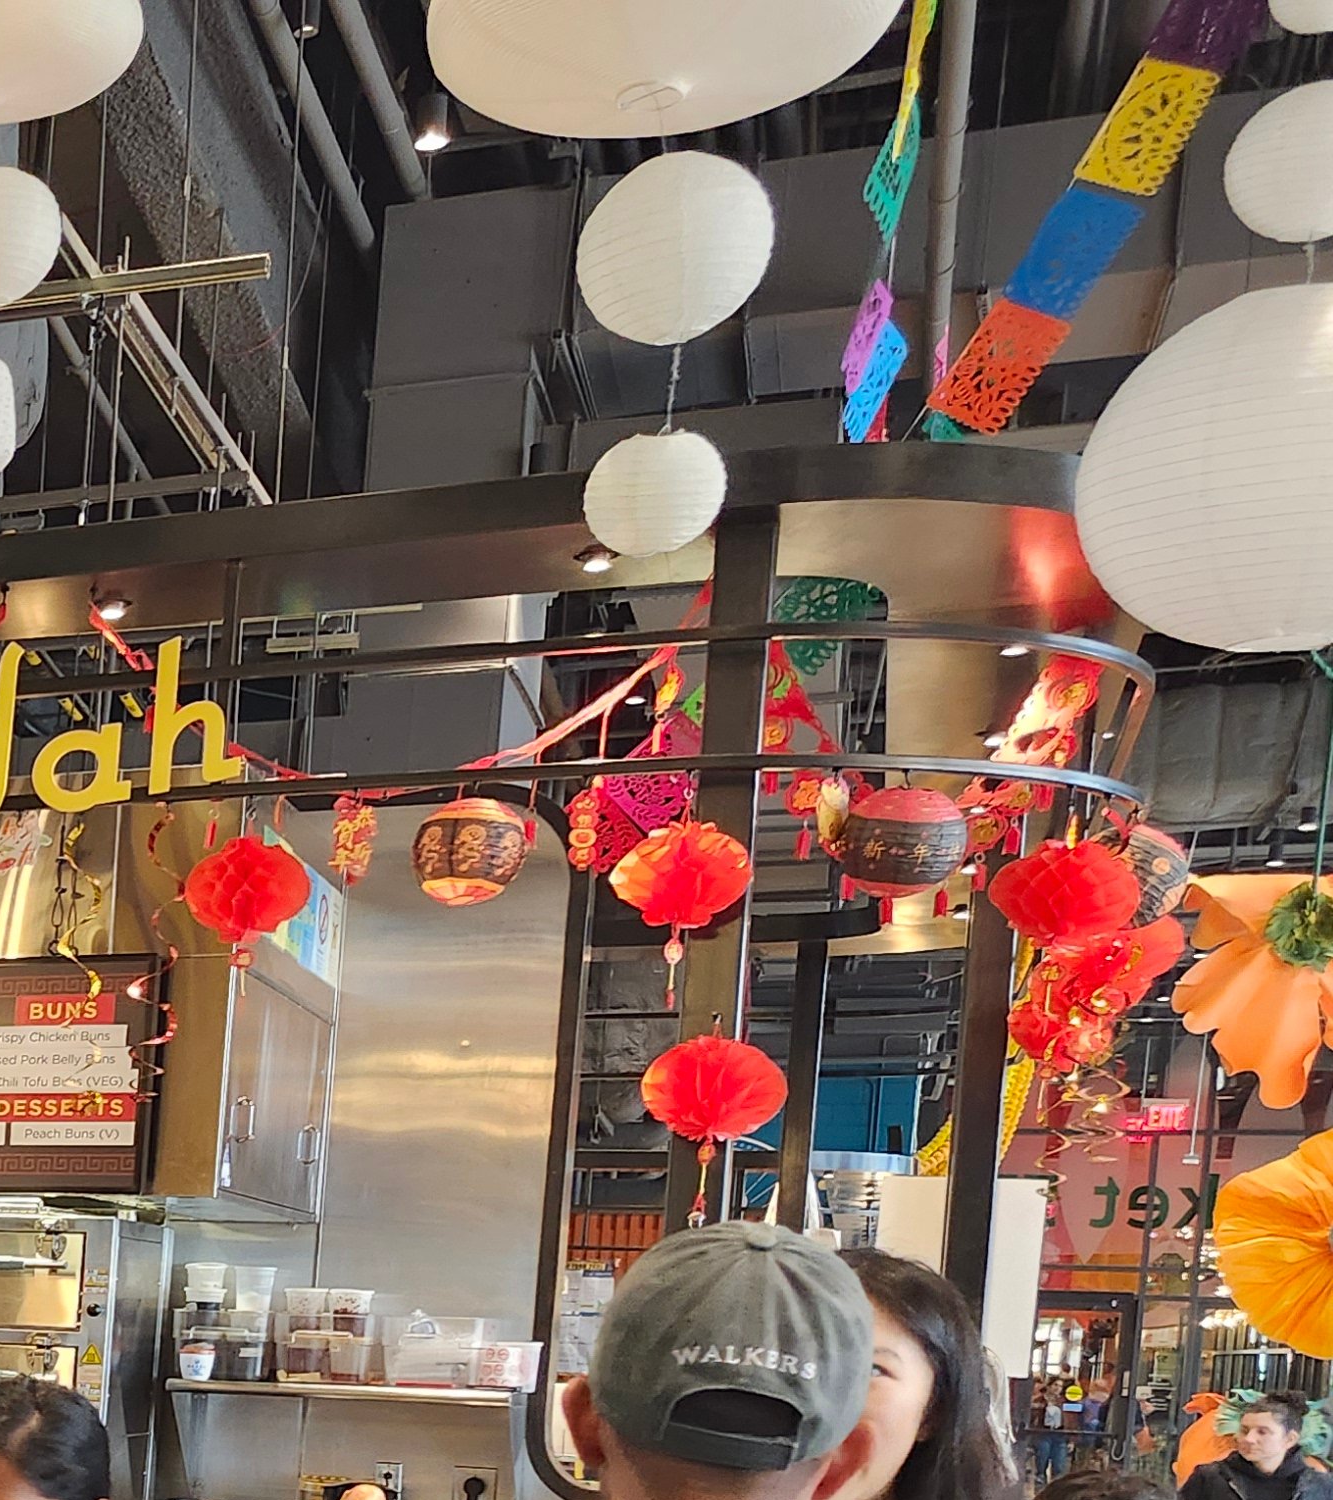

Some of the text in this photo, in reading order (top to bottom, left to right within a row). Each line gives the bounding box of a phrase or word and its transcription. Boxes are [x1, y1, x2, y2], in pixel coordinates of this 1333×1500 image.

[28, 1001, 98, 1020] BUNS
[29, 1031, 75, 1043] Chicken
[81, 1030, 111, 1042] Buns
[20, 1054, 48, 1066] Pork
[52, 1054, 81, 1067] Belly
[23, 1076, 48, 1088] Tofu
[86, 1075, 124, 1089] (VEG)
[1148, 1104, 1188, 1130] EXIT
[24, 1128, 120, 1141] Peach Buns (V)
[671, 1345, 818, 1381] WALKERS
